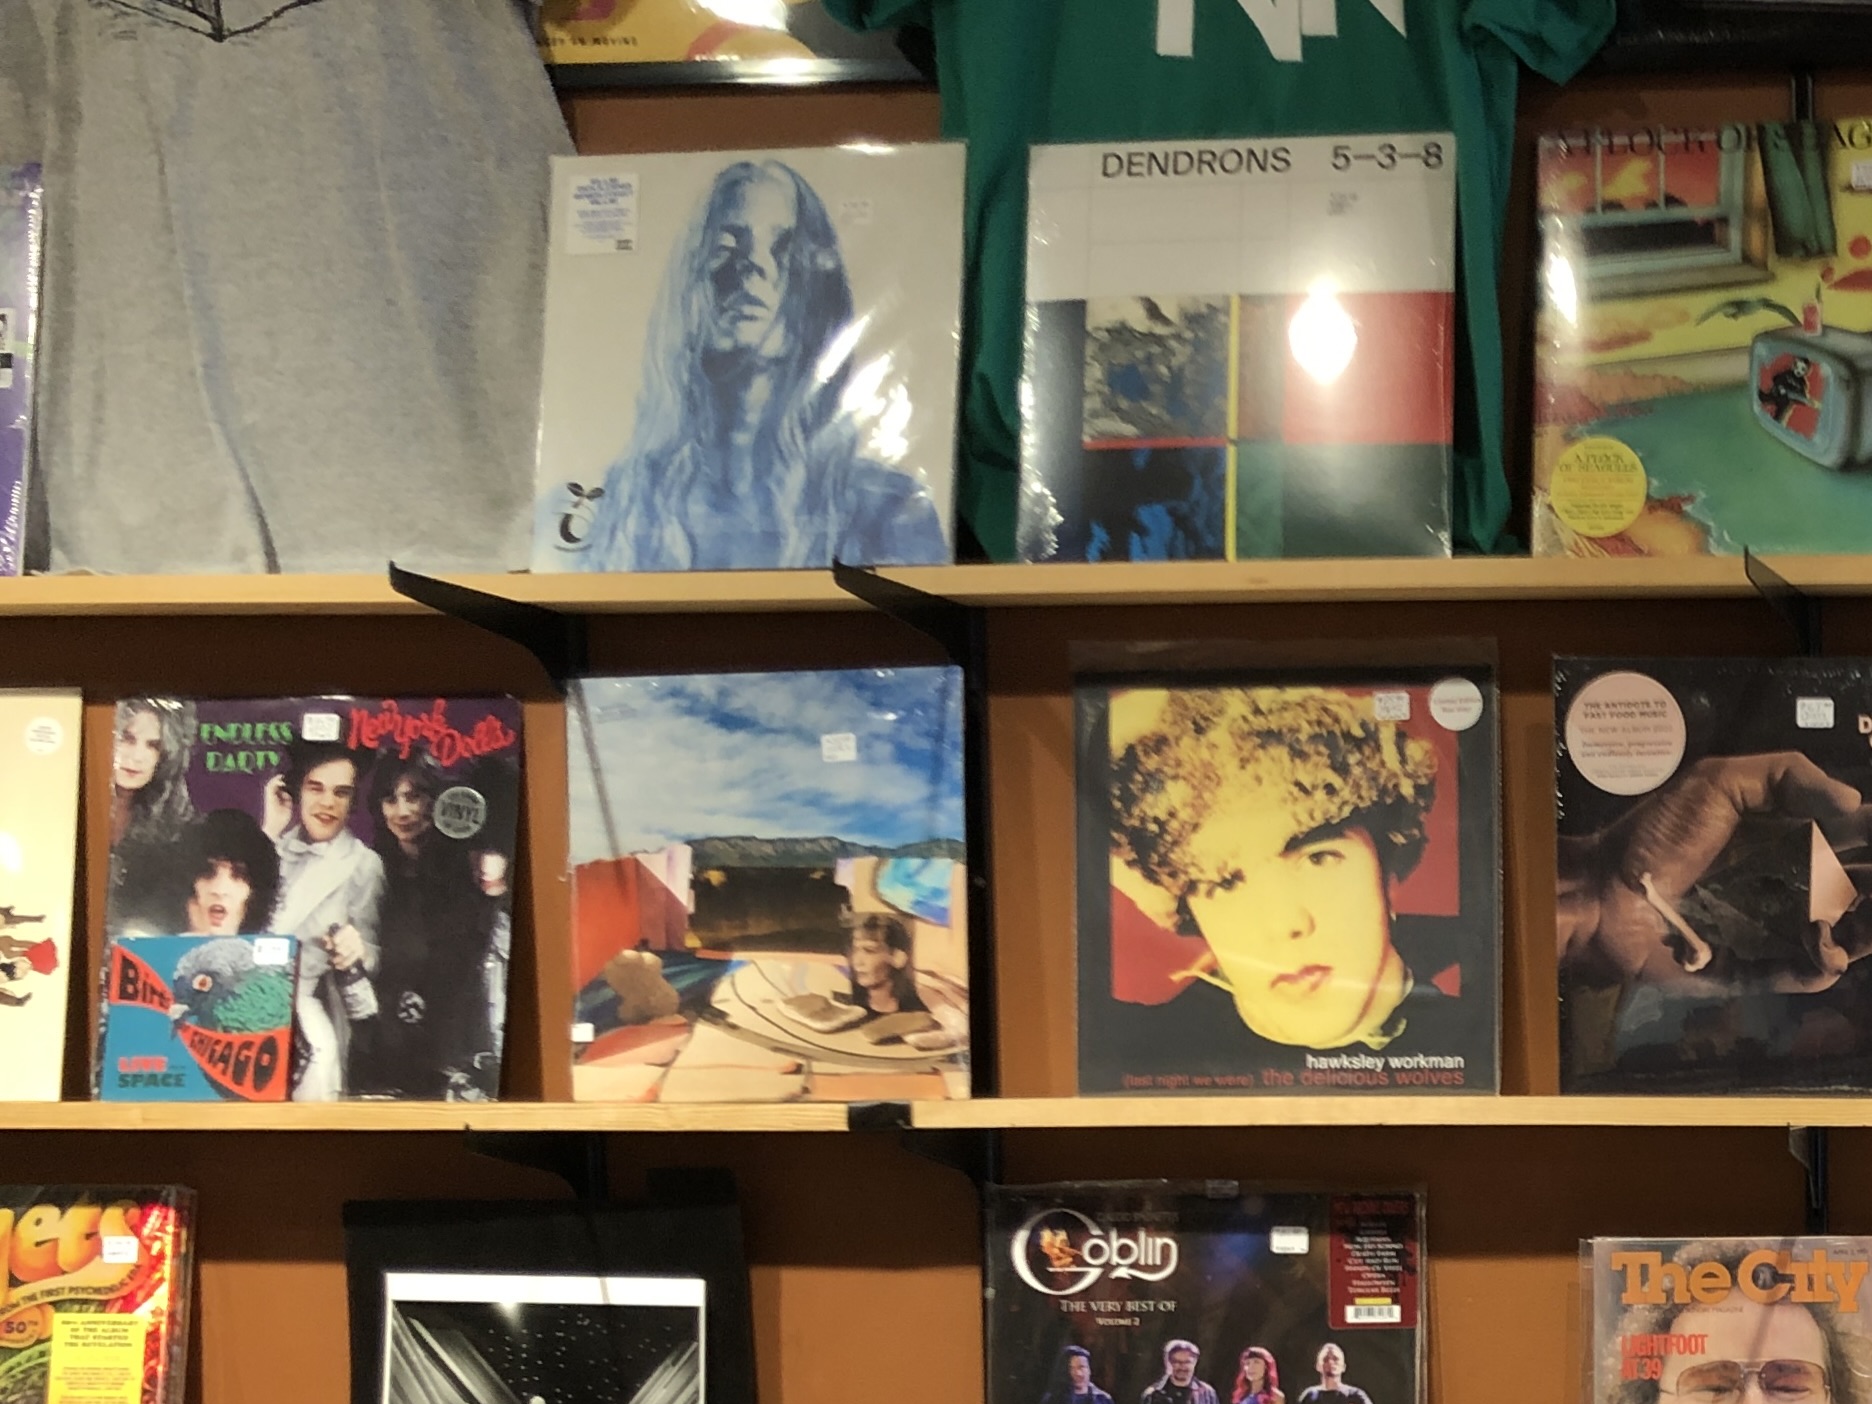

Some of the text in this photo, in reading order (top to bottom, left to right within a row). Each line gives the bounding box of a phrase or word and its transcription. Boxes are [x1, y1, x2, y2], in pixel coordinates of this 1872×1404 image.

[1101, 142, 1444, 178] DENDRONS 5-3-8
[200, 722, 293, 745] ENDLESS
[206, 751, 281, 774] PARTY
[118, 1056, 168, 1073] LIVE
[190, 1030, 279, 1093] CHICAGO
[1305, 1053, 1466, 1072] hawksley workman
[118, 1073, 187, 1089] SPACE
[1010, 1208, 1179, 1296] Goblin
[1611, 1249, 1869, 1313] The City
[1061, 1299, 1178, 1313] THE VERY BEST OF
[1621, 1334, 1708, 1356] LIGHTFOOT
